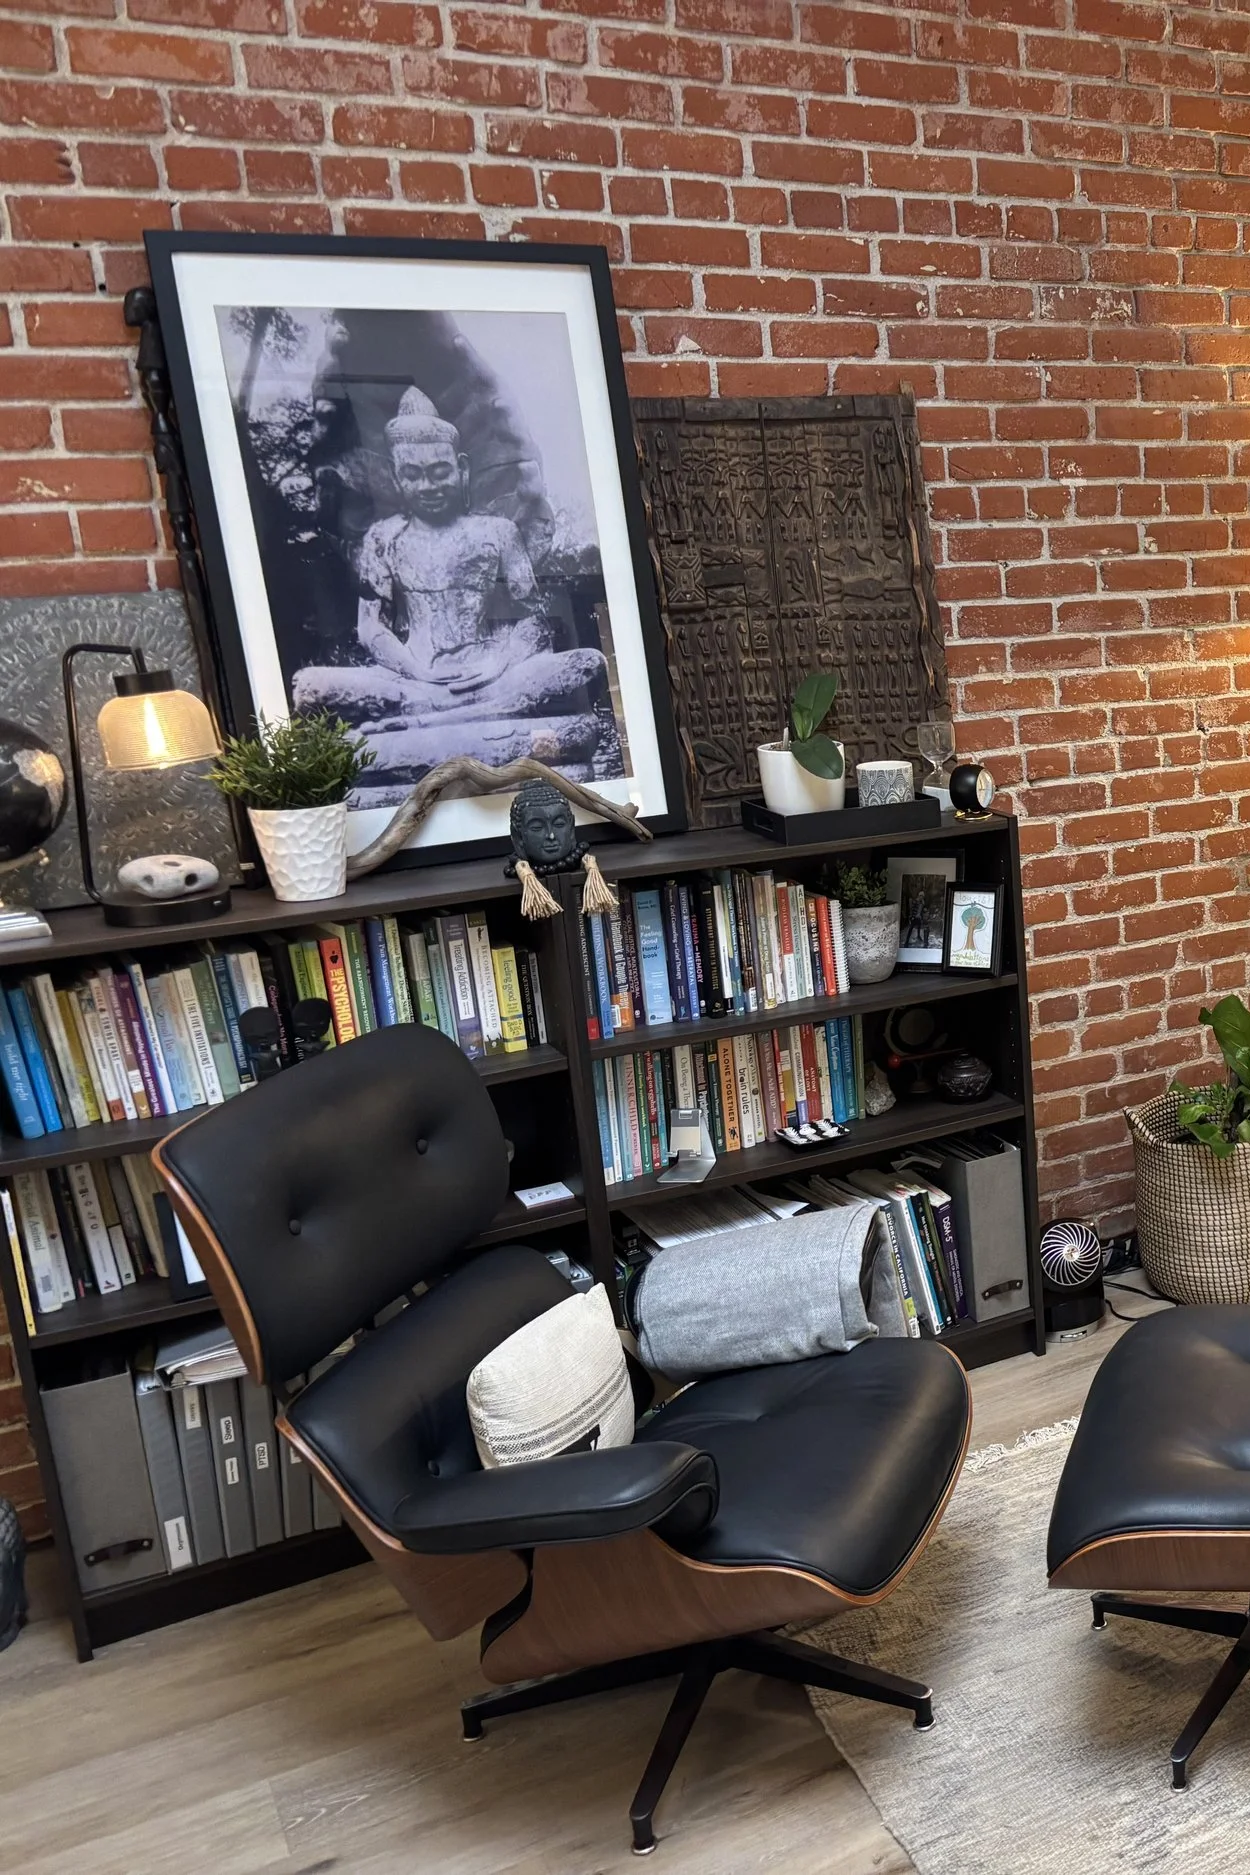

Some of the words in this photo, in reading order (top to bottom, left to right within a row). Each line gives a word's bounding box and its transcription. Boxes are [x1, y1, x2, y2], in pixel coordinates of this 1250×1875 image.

[576, 906, 585, 936] THRIVING
[798, 889, 806, 925] ADHD
[610, 921, 625, 954] Handbook
[670, 918, 679, 943] Counseling
[706, 908, 714, 939] ATTACHMENT
[809, 913, 819, 952] FOCUSING
[451, 943, 466, 971] Treating
[580, 938, 590, 976] ADOLESCENT
[691, 915, 699, 944] TRAUMA
[695, 952, 703, 983] MEMORY
[456, 970, 472, 1001] Addiction
[502, 959, 515, 983] feeling
[595, 956, 609, 1004] WORKBOOK
[615, 962, 628, 984] Couple
[631, 956, 641, 998] MULTICULTURAL
[674, 961, 682, 980] Therapy
[687, 957, 695, 985] BETRAYAL
[356, 970, 367, 1010] ABANDONMENT
[362, 1010, 371, 1033] RECOVER
[381, 959, 392, 997] Management
[387, 998, 397, 1024] Workboo
[422, 980, 432, 1002] APART
[481, 945, 492, 986] BECOMING
[487, 989, 498, 1028] ATTACHED
[504, 983, 517, 1002] good
[522, 976, 532, 1003] QUESTION
[618, 984, 631, 1009] Therapy
[189, 1014, 201, 1029] FIVE
[332, 975, 356, 1044] PSYCHOLOG
[108, 1042, 120, 1062] APART
[117, 1018, 131, 1056] ATTACHMENT
[130, 1021, 145, 1054] Psychology
[193, 1029, 211, 1065] INVITATIONS
[5, 1043, 19, 1064] hold
[15, 1082, 30, 1102] tight
[141, 1060, 151, 1078] Minds
[646, 1057, 654, 1080] walking
[695, 1053, 706, 1084] Attachment
[722, 1048, 731, 1076] ALONE
[794, 1052, 805, 1097] COMMUNICATION
[146, 1078, 158, 1103] Greatest
[626, 1067, 635, 1098] INNER
[682, 1069, 690, 1087] Being
[740, 1068, 748, 1090] brain
[809, 1067, 817, 1092] ANATOMY
[629, 1100, 638, 1131] CHILD
[648, 1089, 656, 1115] eggshells
[725, 1079, 736, 1122] TOGETHER
[741, 1092, 750, 1115] rules
[19, 1175, 32, 1191] The
[29, 1219, 45, 1251] Animal
[942, 1216, 953, 1242] DSM-5
[886, 1212, 898, 1244] DIVORCE
[895, 1254, 909, 1296] CALIFORNIA
[224, 1420, 232, 1441] Sleep
